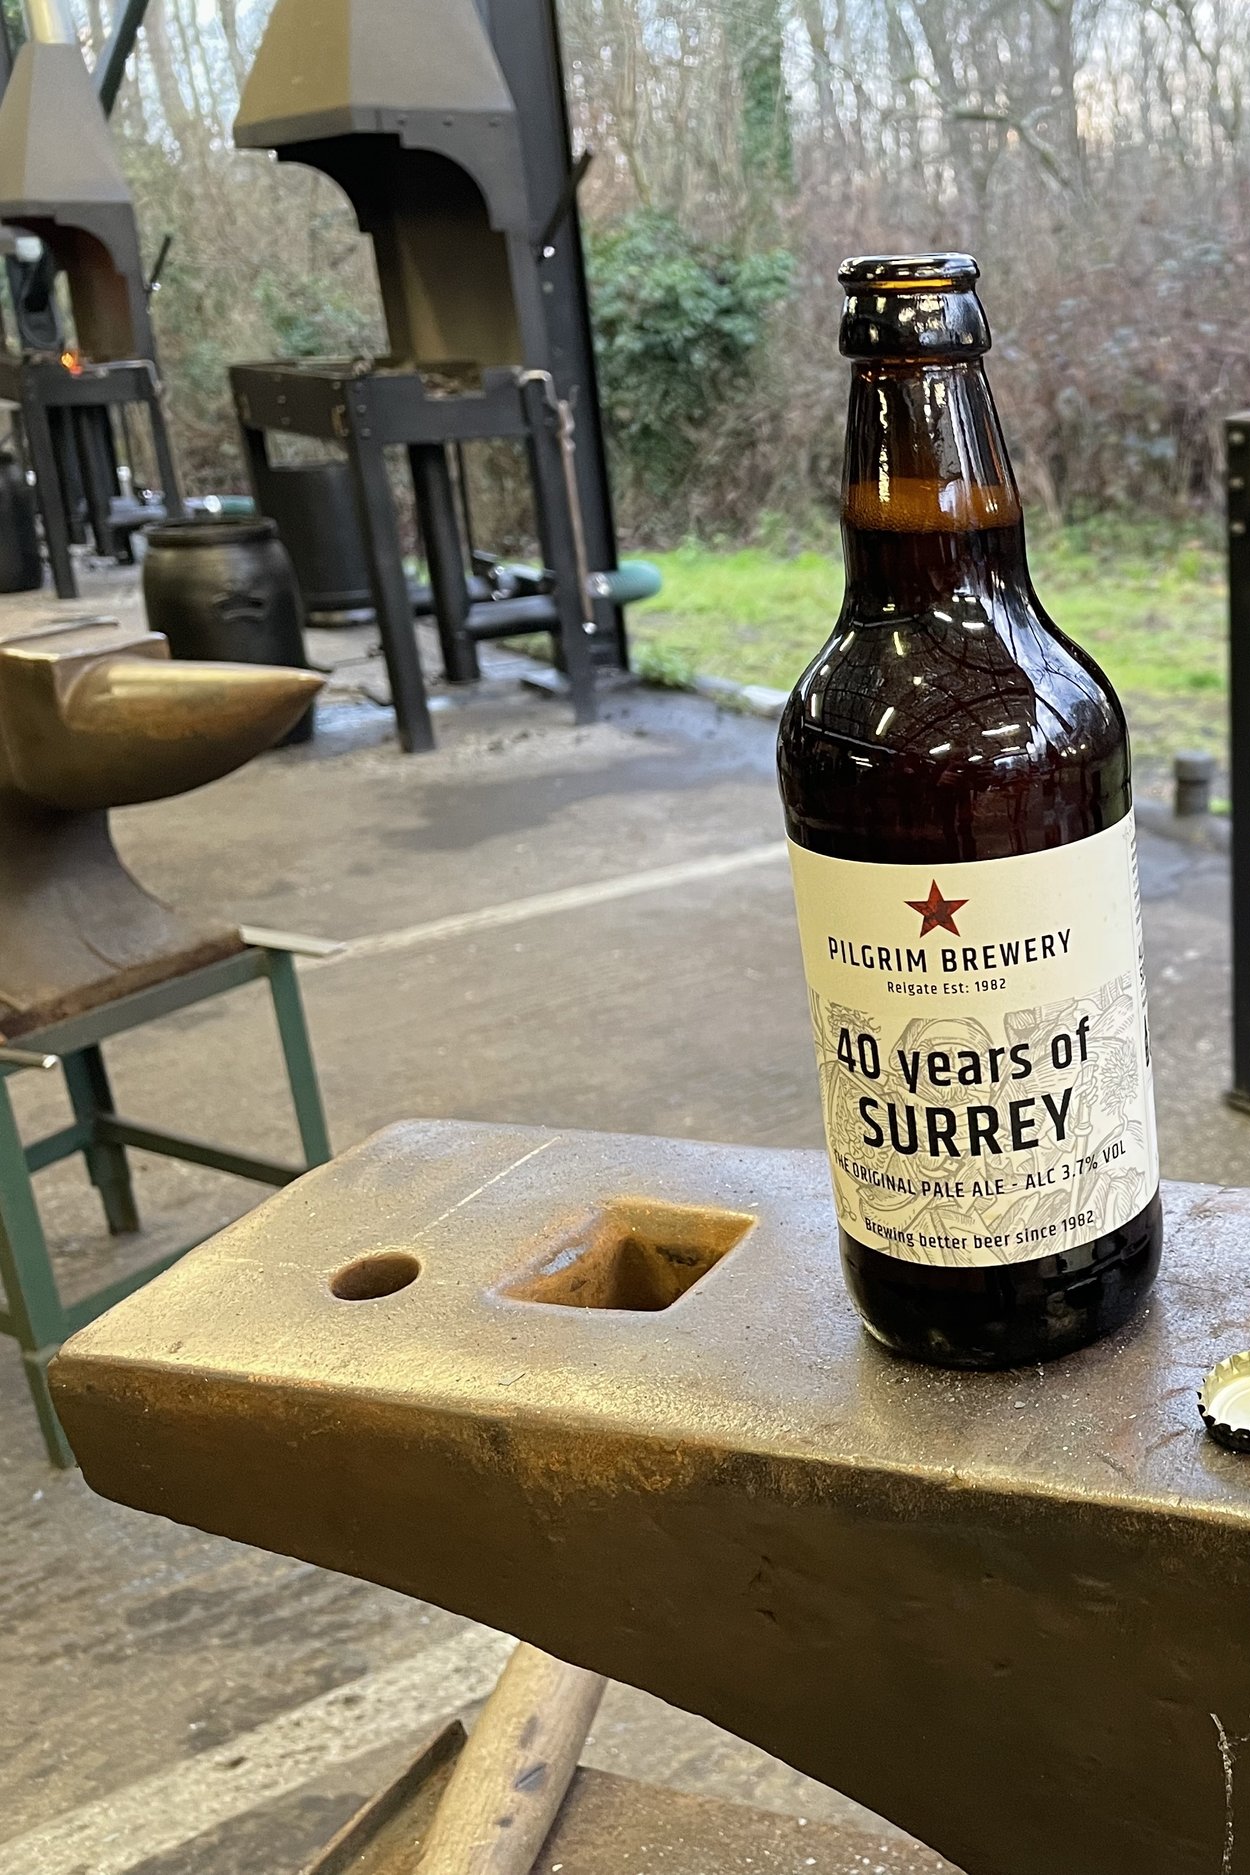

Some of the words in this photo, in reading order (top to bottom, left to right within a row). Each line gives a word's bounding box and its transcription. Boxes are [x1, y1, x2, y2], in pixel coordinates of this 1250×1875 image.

[828, 936, 927, 973] PILGRIM
[941, 928, 1071, 973] BREWERY
[887, 981, 938, 996] Reigate
[943, 981, 969, 995] Est:
[974, 978, 1007, 993] 1982
[837, 1027, 881, 1080] 40
[896, 1042, 1033, 1094] years
[1050, 1015, 1090, 1070] of
[858, 1086, 1073, 1158] SURREY
[834, 1148, 851, 1174] THE
[852, 1162, 917, 1196] ORIGINAL
[921, 1180, 965, 1198] PALE
[972, 1179, 1005, 1198] ALE
[1025, 1168, 1056, 1190] ALC
[1062, 1154, 1098, 1181] 3.7%
[1103, 1140, 1127, 1164] VOL
[865, 1217, 915, 1247] Brewing
[918, 1232, 968, 1249] better
[973, 1233, 1010, 1249] beer
[1016, 1224, 1057, 1245] since
[1061, 1210, 1094, 1233] 1982
